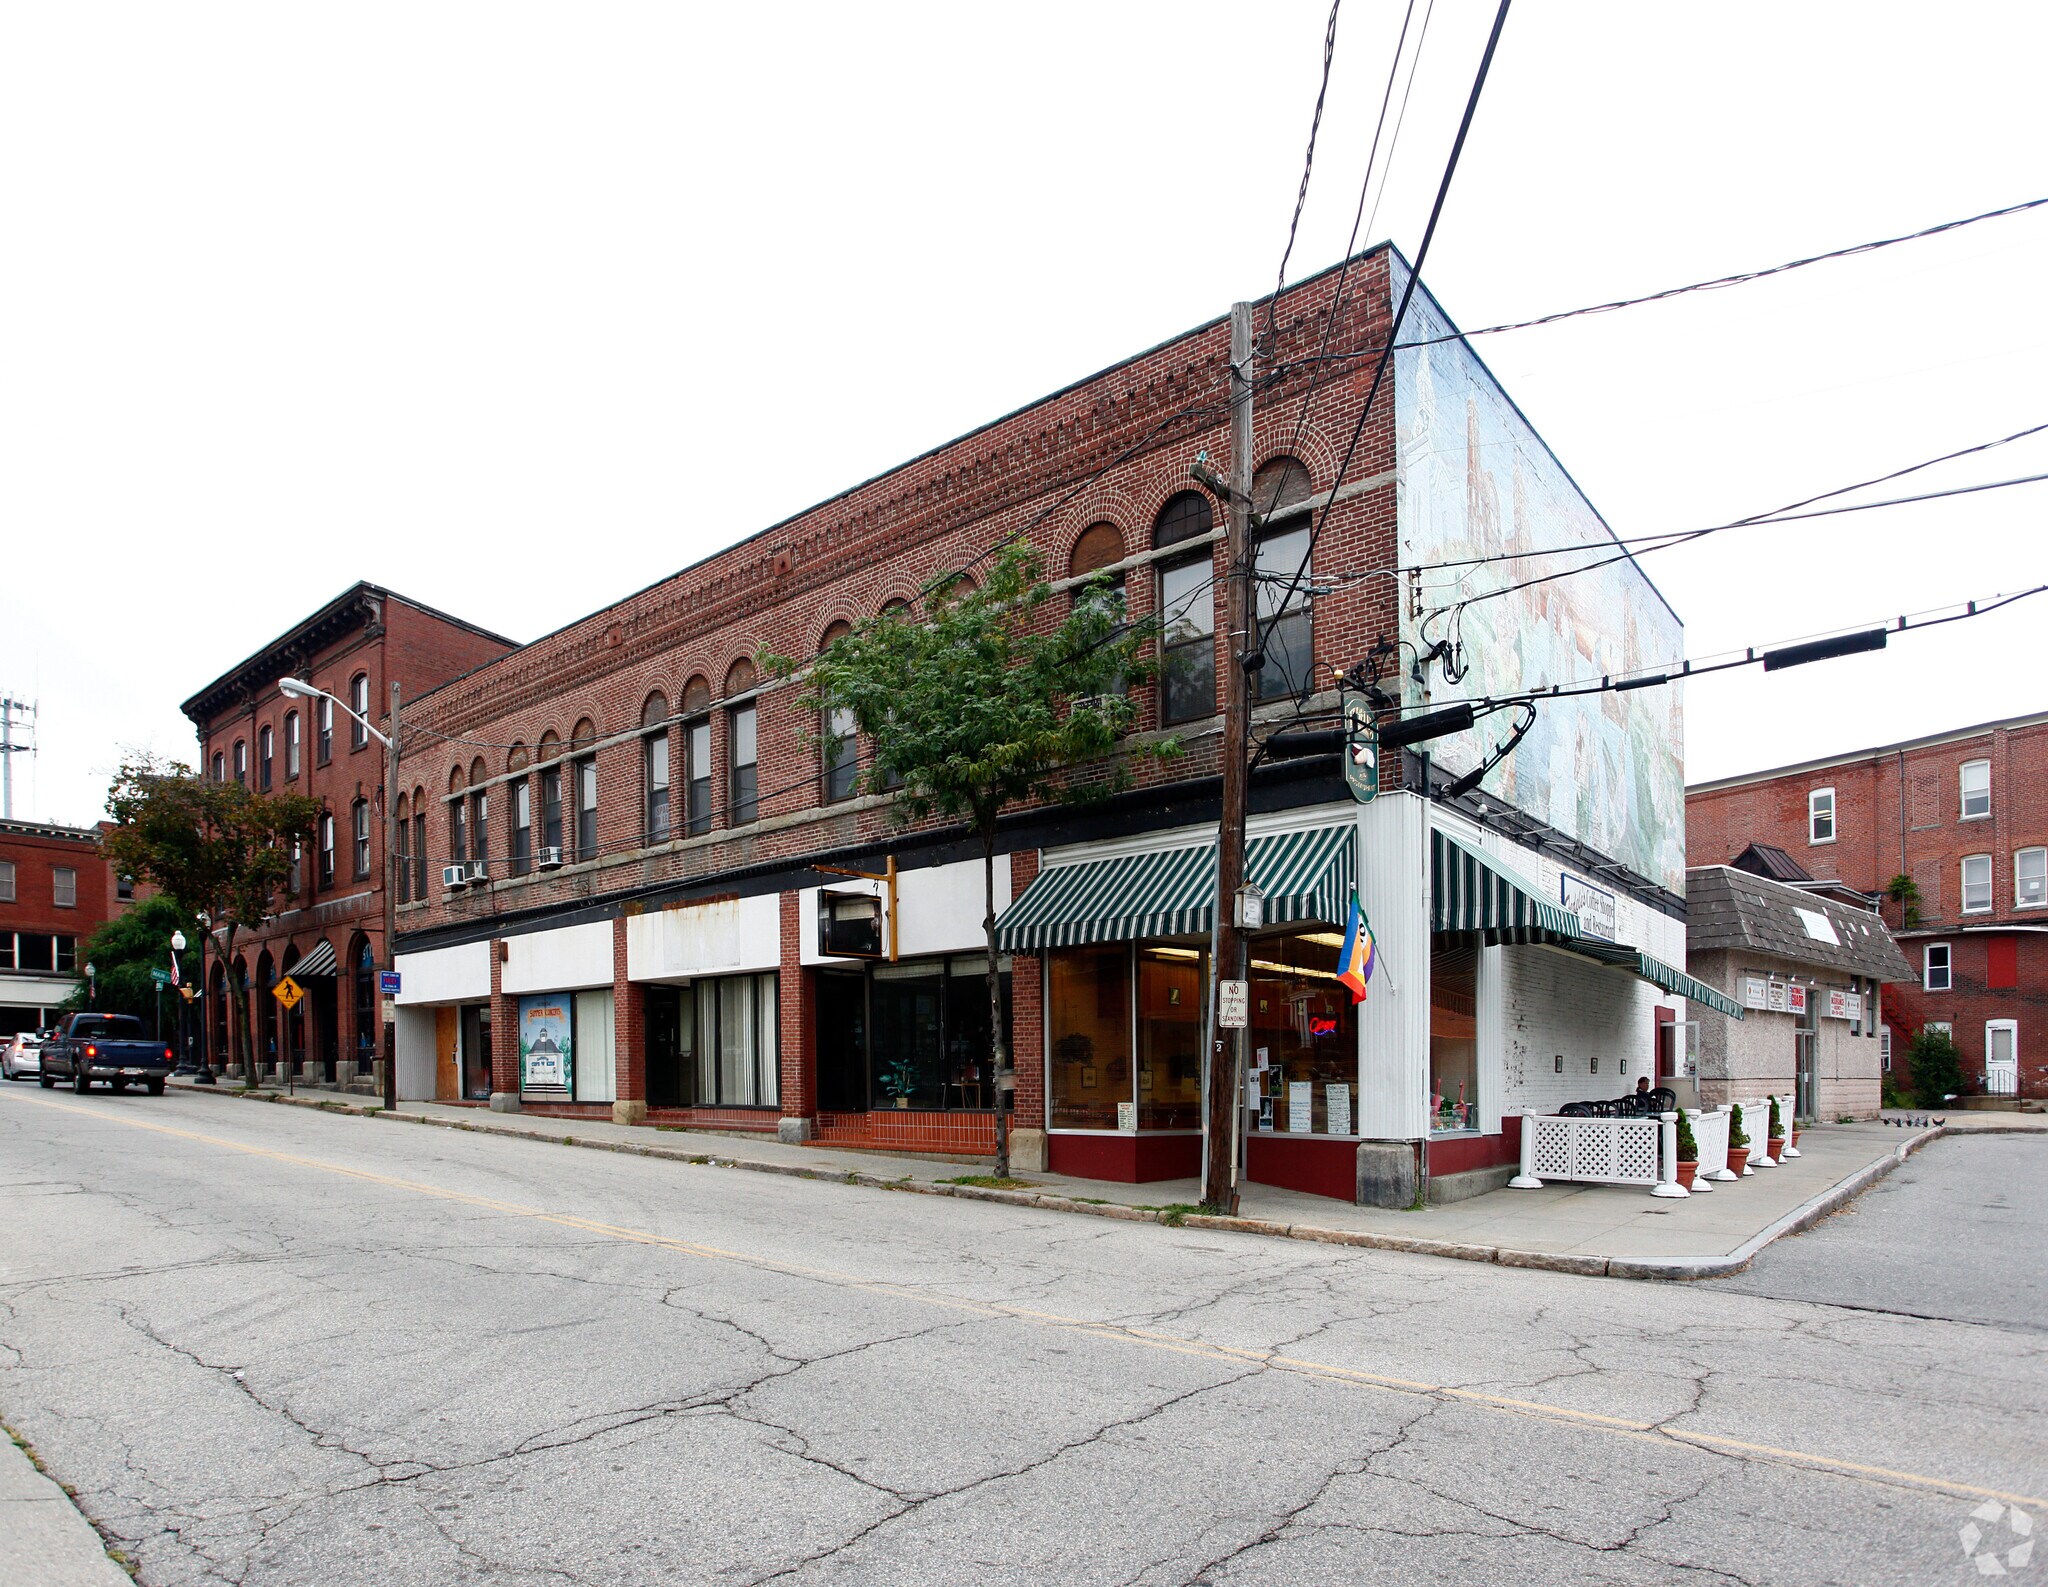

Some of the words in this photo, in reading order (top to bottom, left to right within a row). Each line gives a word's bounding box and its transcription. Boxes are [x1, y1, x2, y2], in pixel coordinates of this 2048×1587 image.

[1587, 889, 1599, 912] Coffee
[1228, 985, 1239, 995] NO
[1309, 1017, 1337, 1033] Open
[1216, 1043, 1222, 1052] 2
